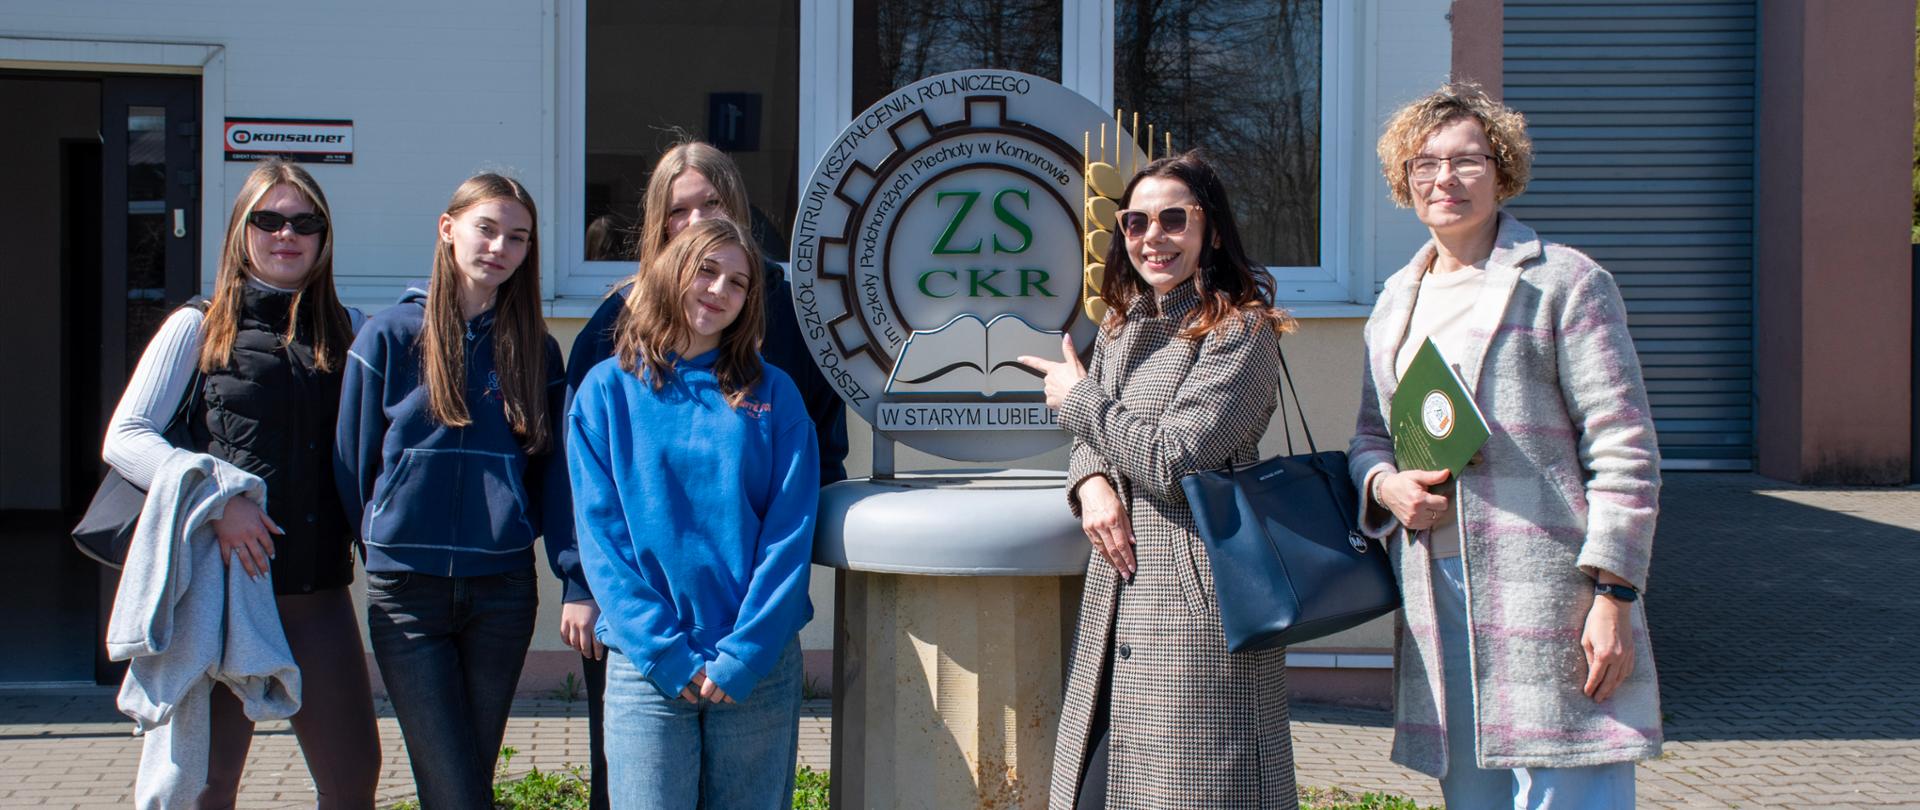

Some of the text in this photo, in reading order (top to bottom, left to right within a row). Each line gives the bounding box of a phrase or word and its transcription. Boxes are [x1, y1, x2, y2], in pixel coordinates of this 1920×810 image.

[797, 75, 1030, 407] ZESPÓŁ SZKÓŁ CENTRUM KSZTAŁCENIA ROLNICZEGO
[860, 140, 1070, 349] im. Szkoły Podchorążych Piechoty w Komorowie
[931, 188, 1033, 256] ZS
[918, 268, 1059, 299] CKR
[882, 408, 1059, 426] W STARYM LUBIEJE
